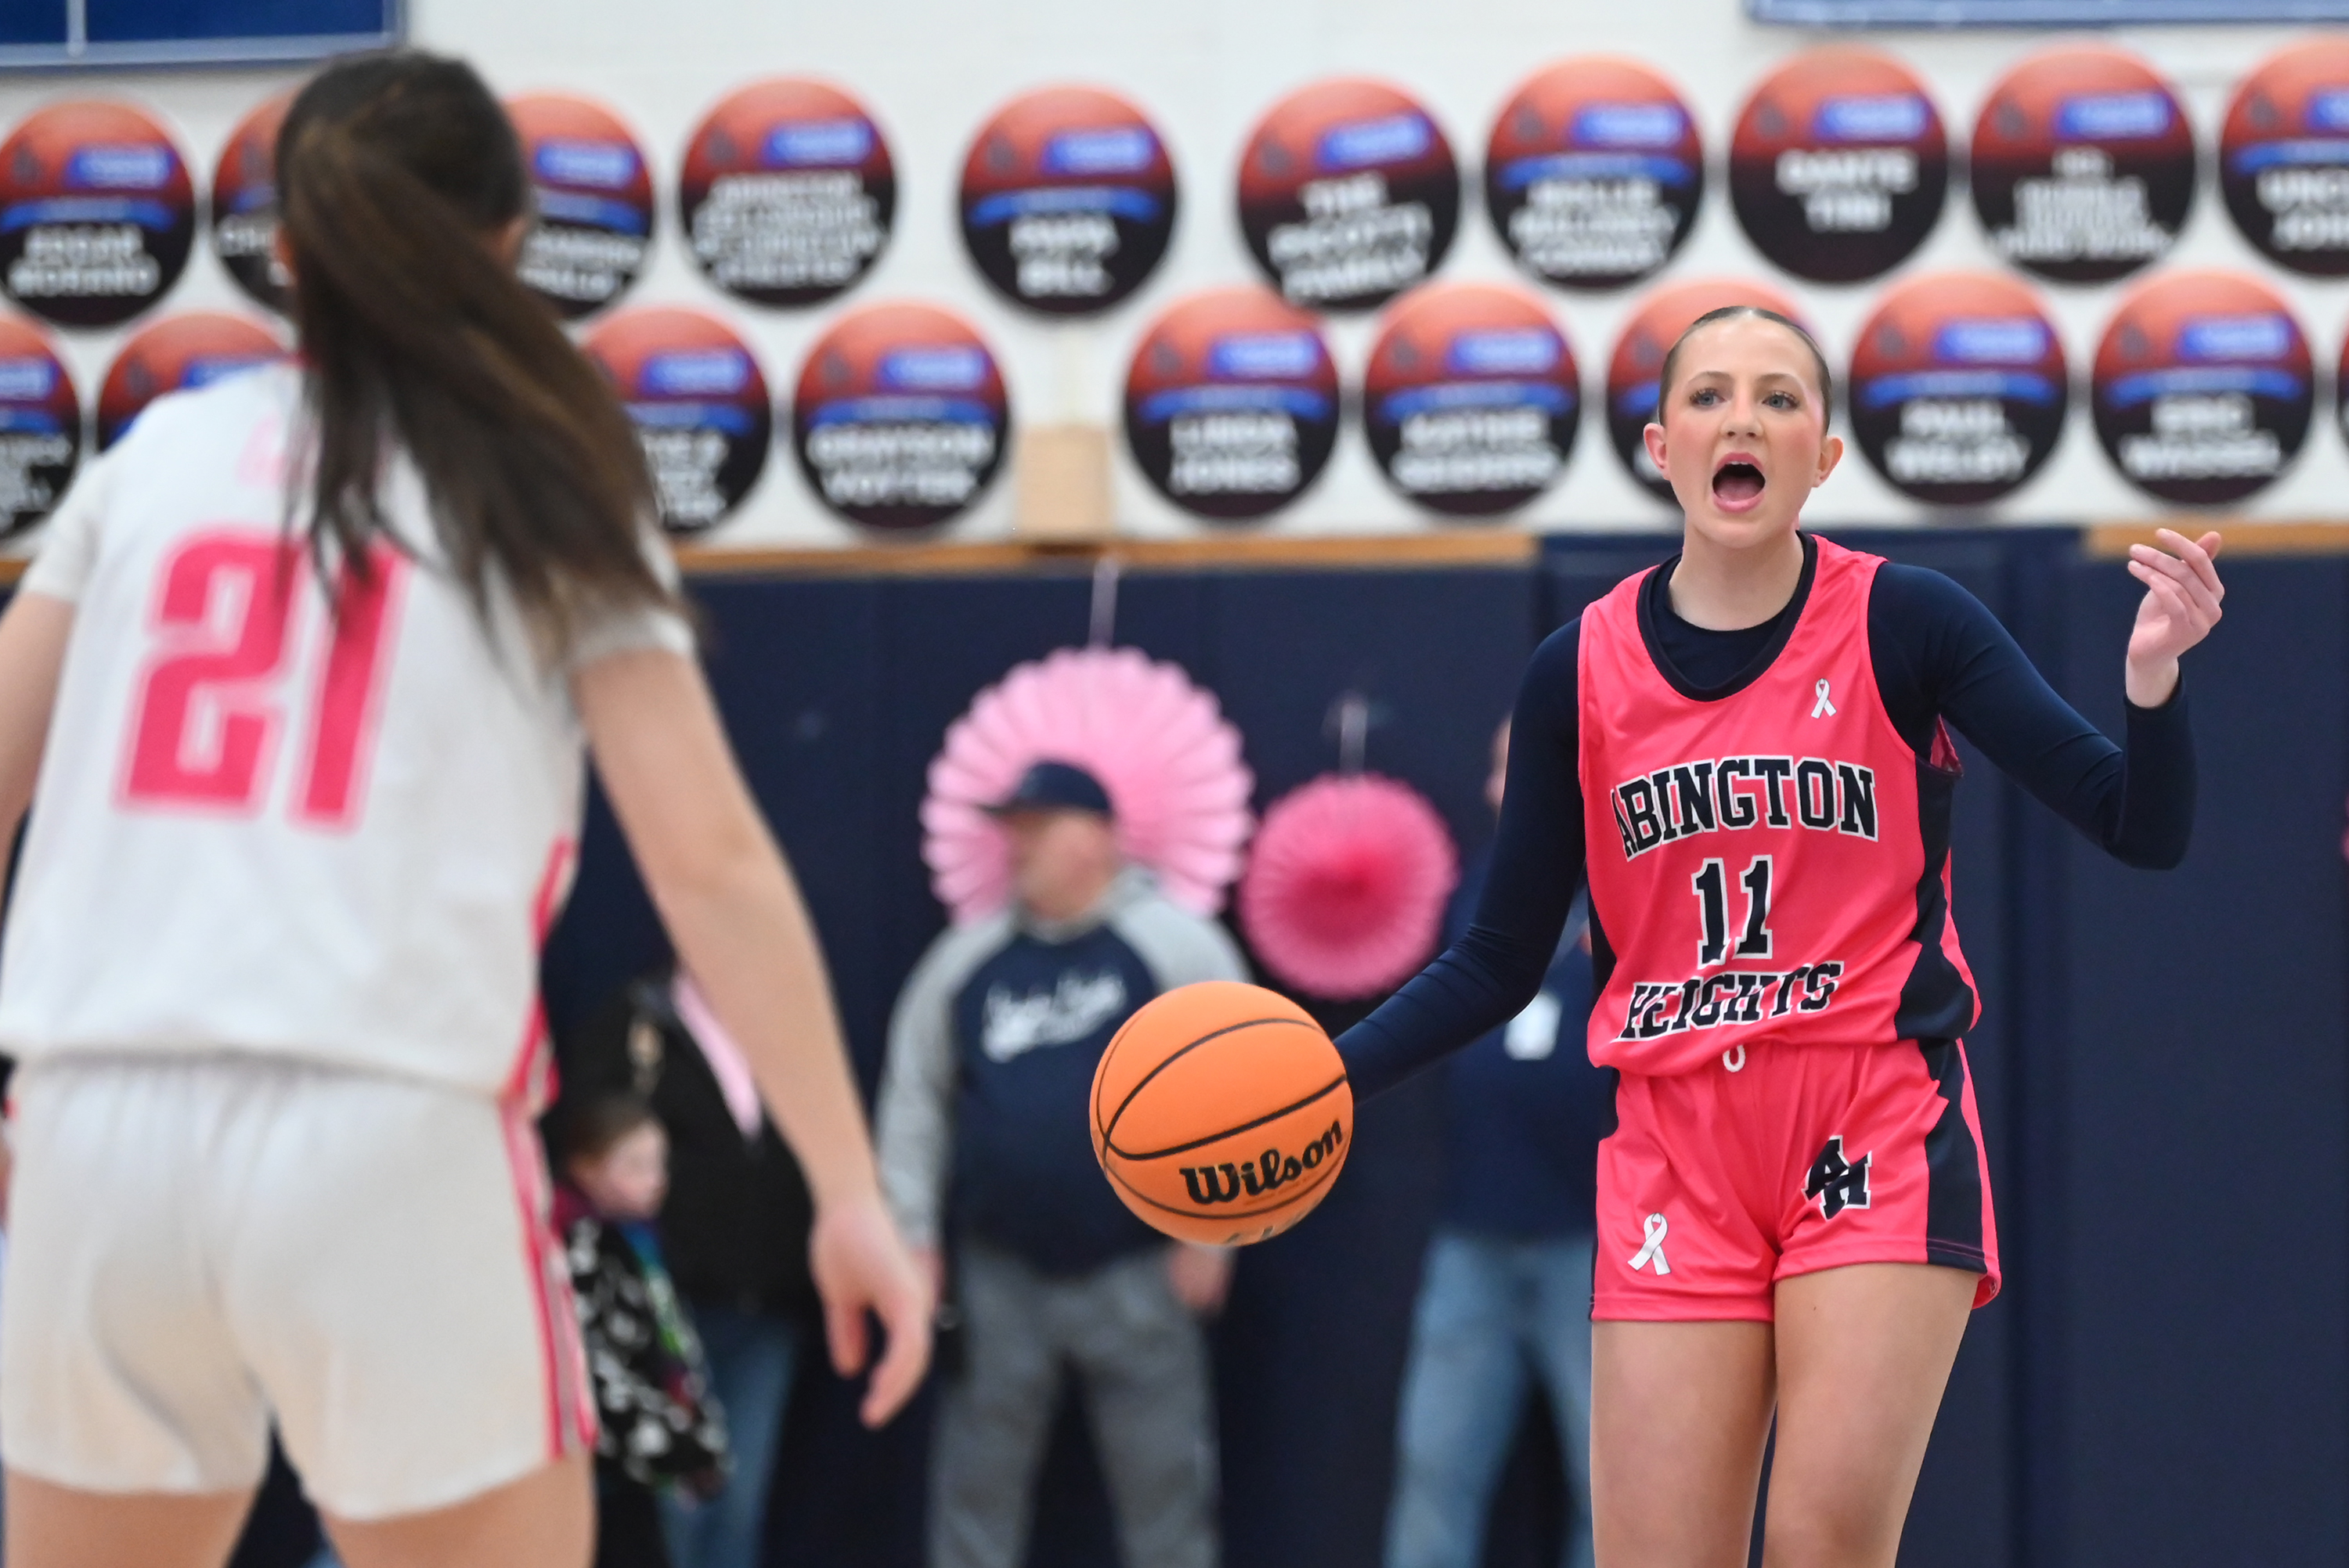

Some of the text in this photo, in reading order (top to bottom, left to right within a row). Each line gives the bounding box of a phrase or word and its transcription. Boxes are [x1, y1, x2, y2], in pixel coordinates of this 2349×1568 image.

[713, 174, 861, 205] ABINGTON
[1776, 149, 1918, 194] DANTE
[1301, 172, 1387, 218] THE
[1531, 179, 1659, 211] MOLLIE
[1010, 216, 1118, 257] PAPA
[1511, 209, 1679, 241] MALONEY
[1018, 258, 1110, 296] BILL
[1284, 249, 1428, 302] FAMILY
[1172, 413, 1296, 452] LINDA
[1401, 409, 1547, 449] KATHIE
[1901, 399, 2004, 435] PAUL
[2152, 396, 2253, 432] ERIC
[807, 424, 994, 467] GRAYSON
[1885, 437, 2030, 482] WELBY
[2120, 434, 2279, 479] WASSEL
[821, 467, 976, 505] VOYTEK
[1168, 452, 1300, 494] JONES
[113, 524, 413, 836] 21
[1611, 755, 1879, 863] ABINGTON
[1690, 854, 1773, 970] 11
[1611, 961, 1845, 1044] HEIGHTS
[1179, 1119, 1344, 1205] Wilson
